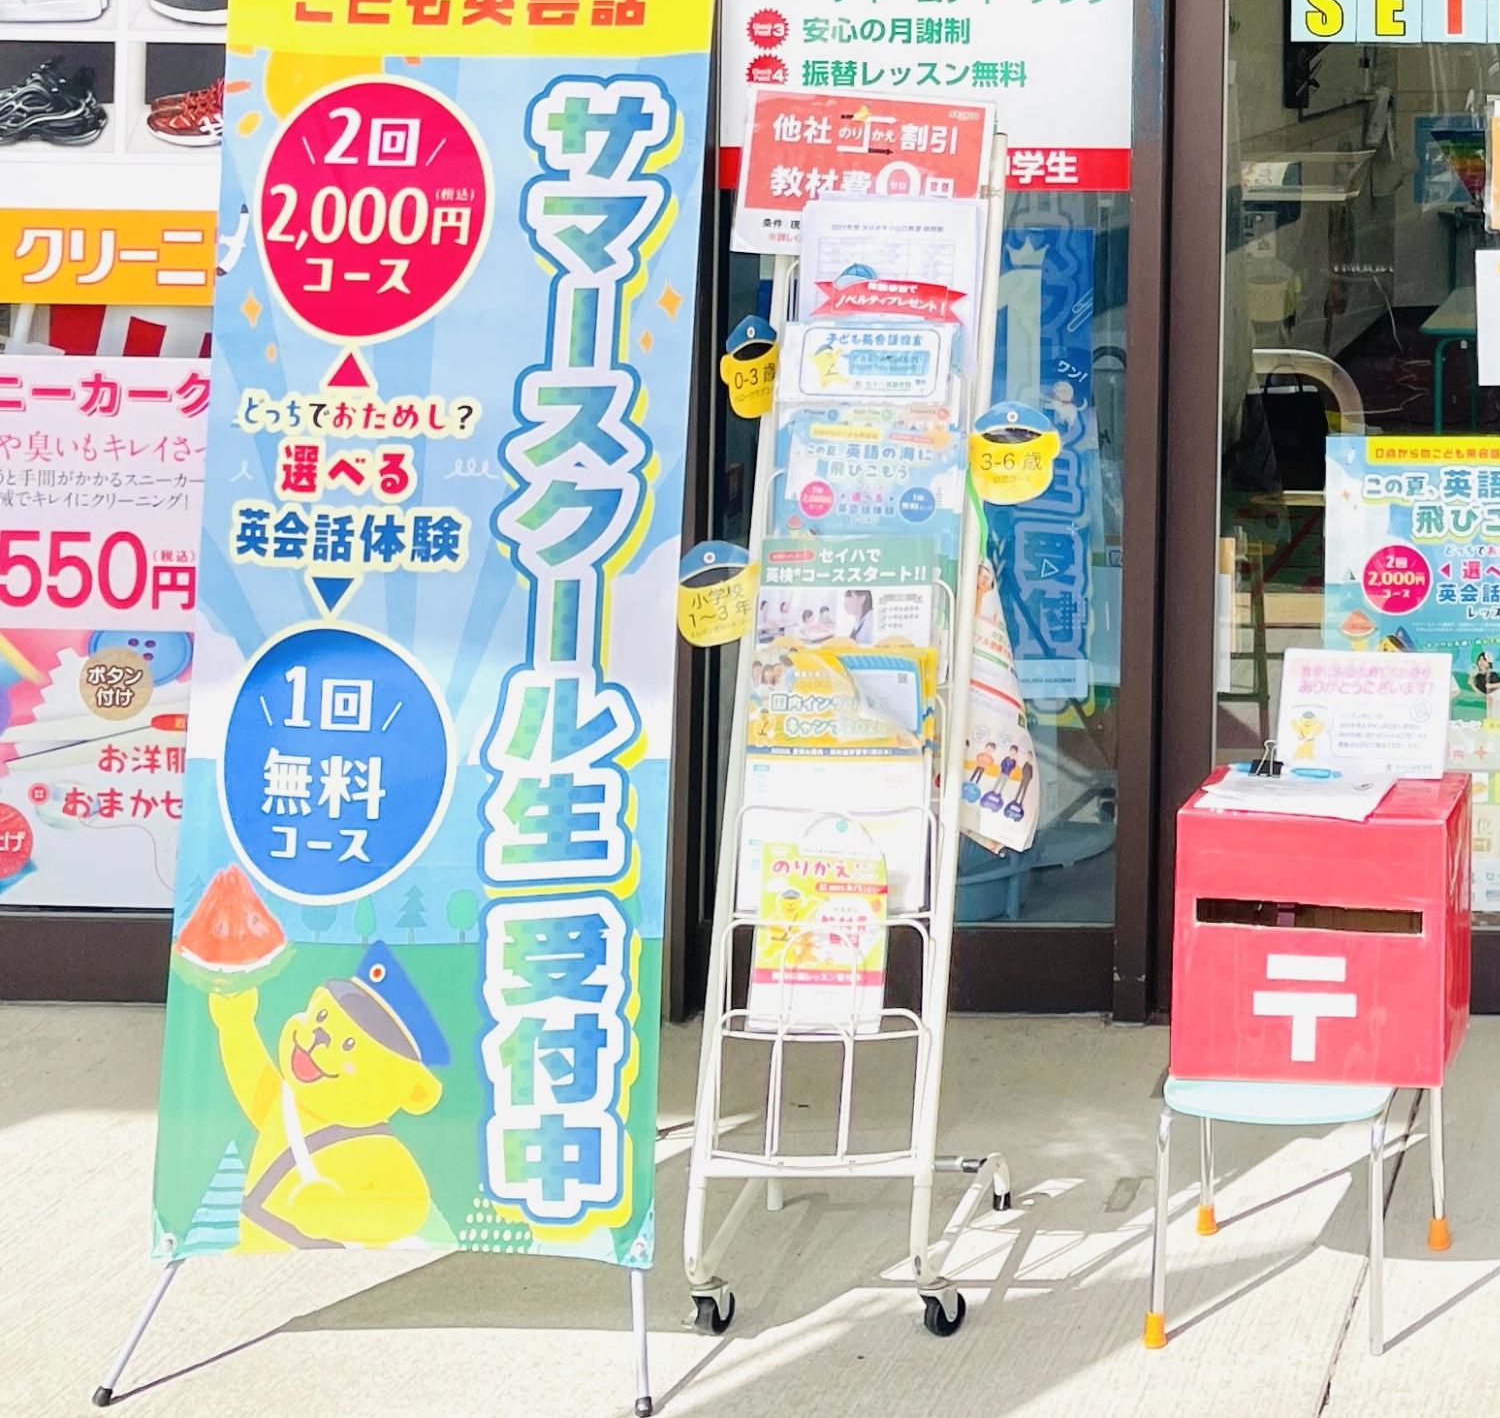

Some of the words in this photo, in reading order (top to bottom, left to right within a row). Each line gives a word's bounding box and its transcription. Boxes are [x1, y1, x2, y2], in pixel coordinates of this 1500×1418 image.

[802, 18, 971, 45] 安心の月謝制
[802, 61, 1027, 88] 振替レッスン無料
[323, 106, 422, 168] 2回
[1005, 150, 1079, 184] 学生
[266, 184, 472, 252] 2,000円
[15, 228, 217, 285] クリーニ
[302, 257, 411, 295] コース
[734, 367, 759, 390] 0-3
[243, 397, 475, 431] どっちでおためし?
[280, 444, 411, 496] 選べる
[980, 452, 1015, 471] 3-6
[1022, 451, 1042, 471] 歳
[235, 507, 464, 564] 英会話体験
[818, 547, 882, 564] セイハで
[1384, 556, 1409, 570] 2回
[1367, 570, 1426, 587] 2,000円
[1381, 589, 1411, 599] コース
[691, 582, 745, 610] 小学校
[735, 599, 753, 616] 年
[95, 688, 135, 708] 付け
[283, 665, 375, 732] 1回
[260, 748, 387, 821] 無料
[269, 825, 371, 863] コース
[498, 912, 611, 1203] 受付中
